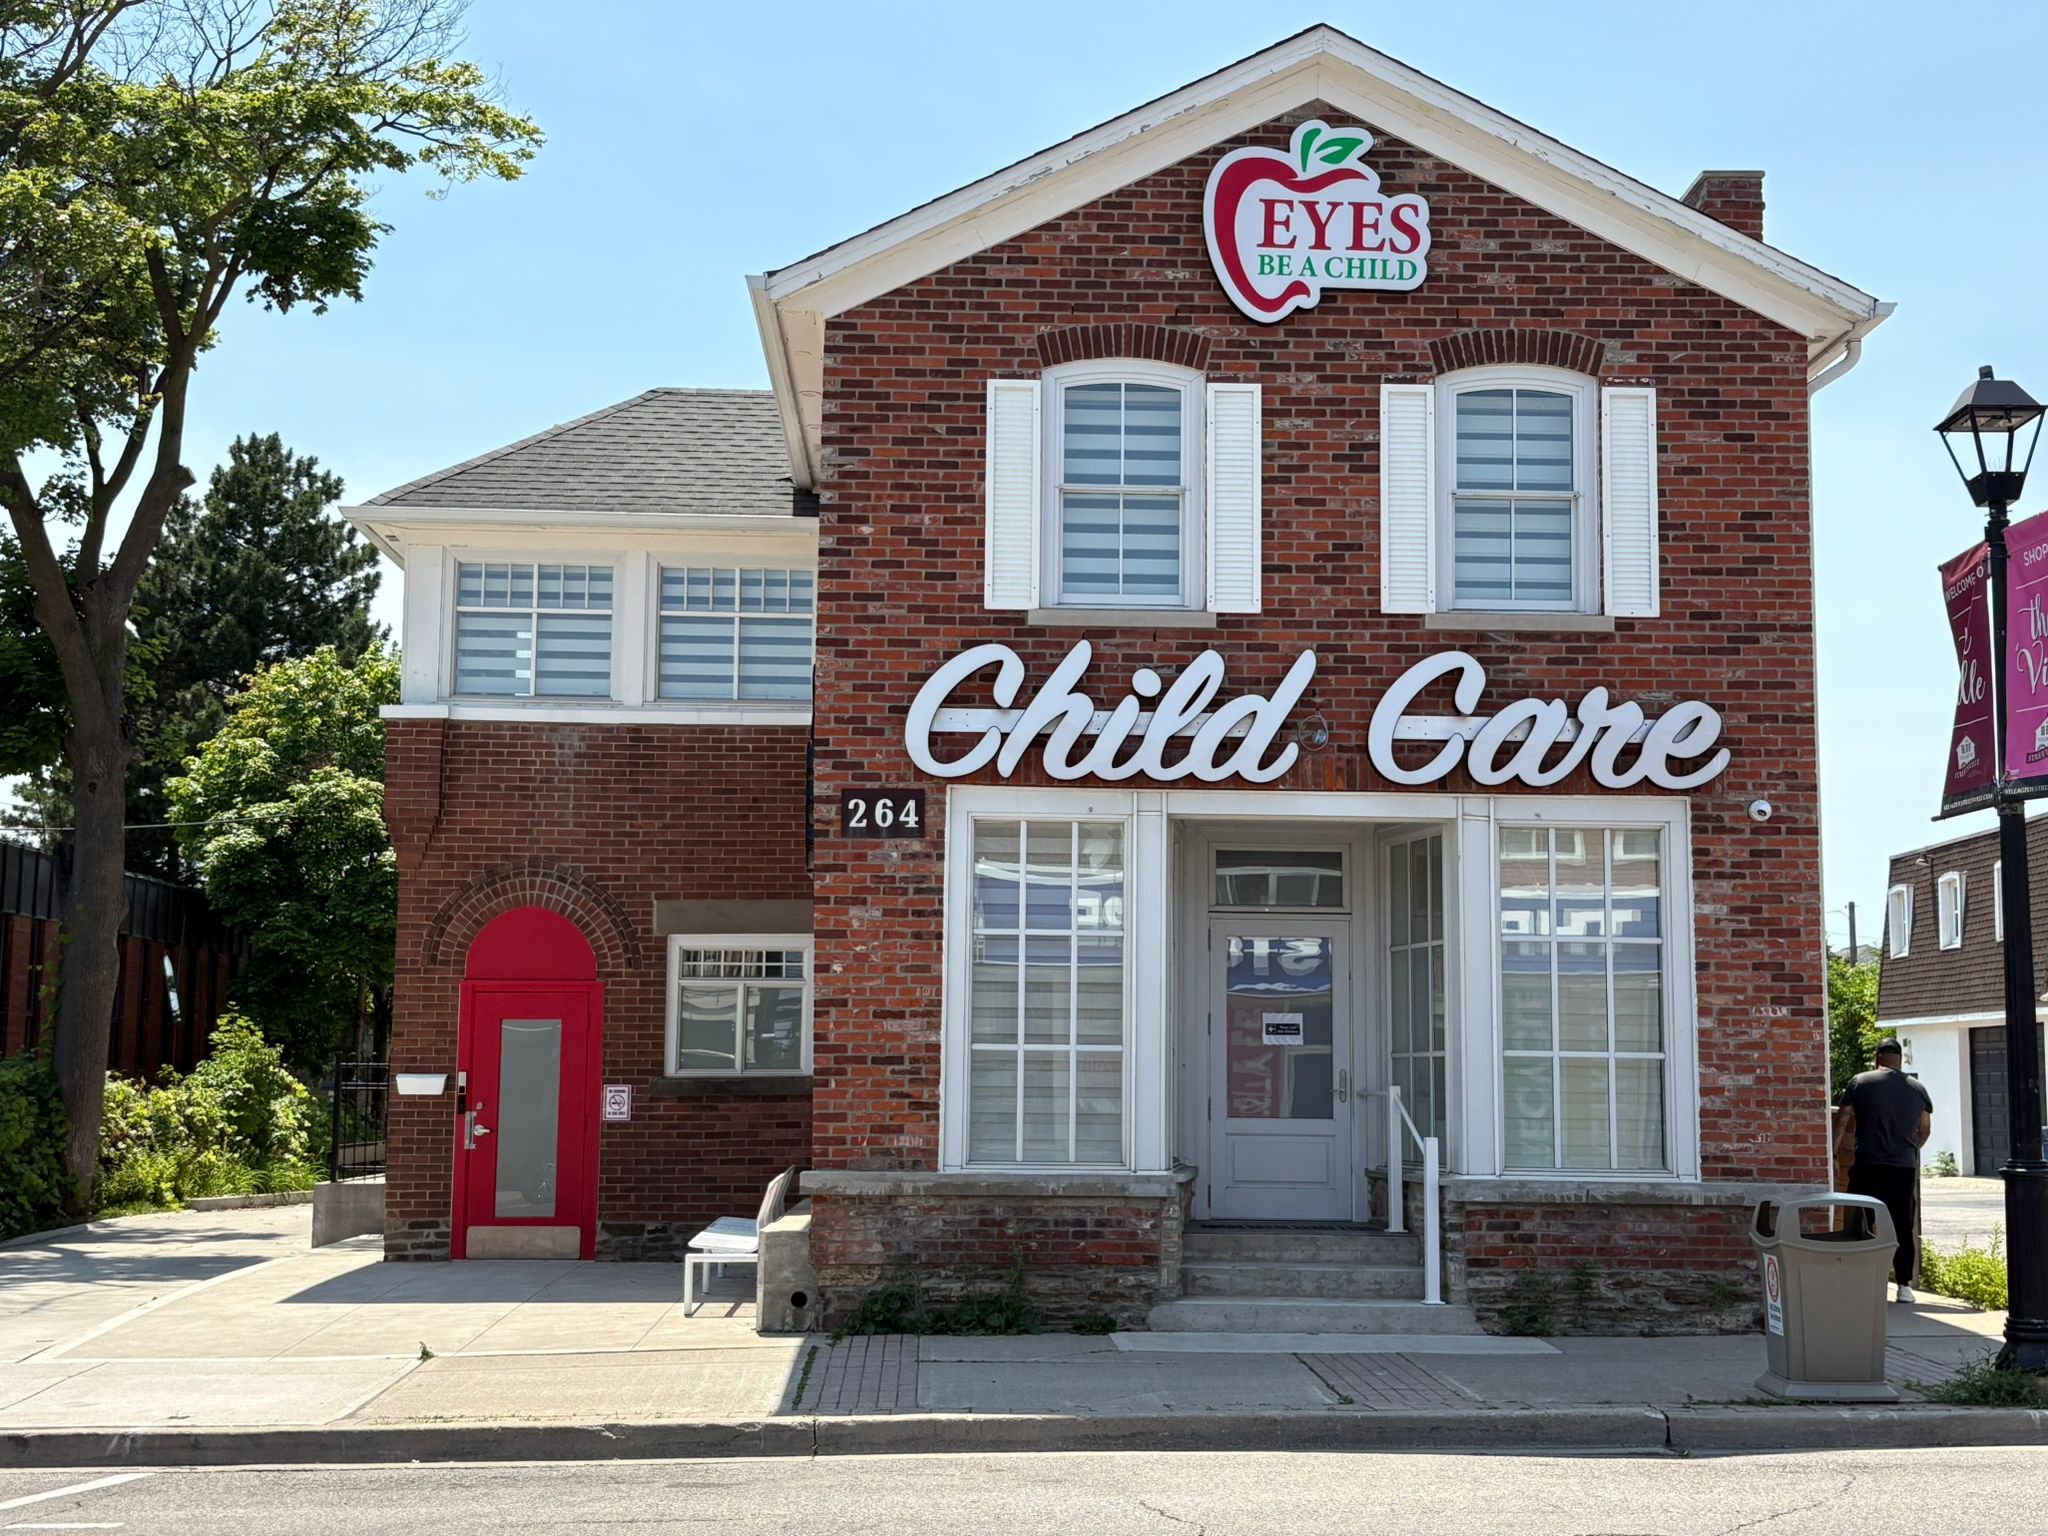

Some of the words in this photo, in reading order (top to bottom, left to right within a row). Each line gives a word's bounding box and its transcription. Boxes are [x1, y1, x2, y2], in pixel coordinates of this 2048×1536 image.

[1256, 198, 1421, 255] EYES
[1258, 254, 1293, 276] BE
[1298, 255, 1318, 278] A
[1324, 256, 1418, 281] CHILD
[1945, 572, 1976, 603] WELCOME
[904, 639, 1317, 785] Child
[1367, 649, 1731, 791] Care
[847, 798, 919, 828] 264
